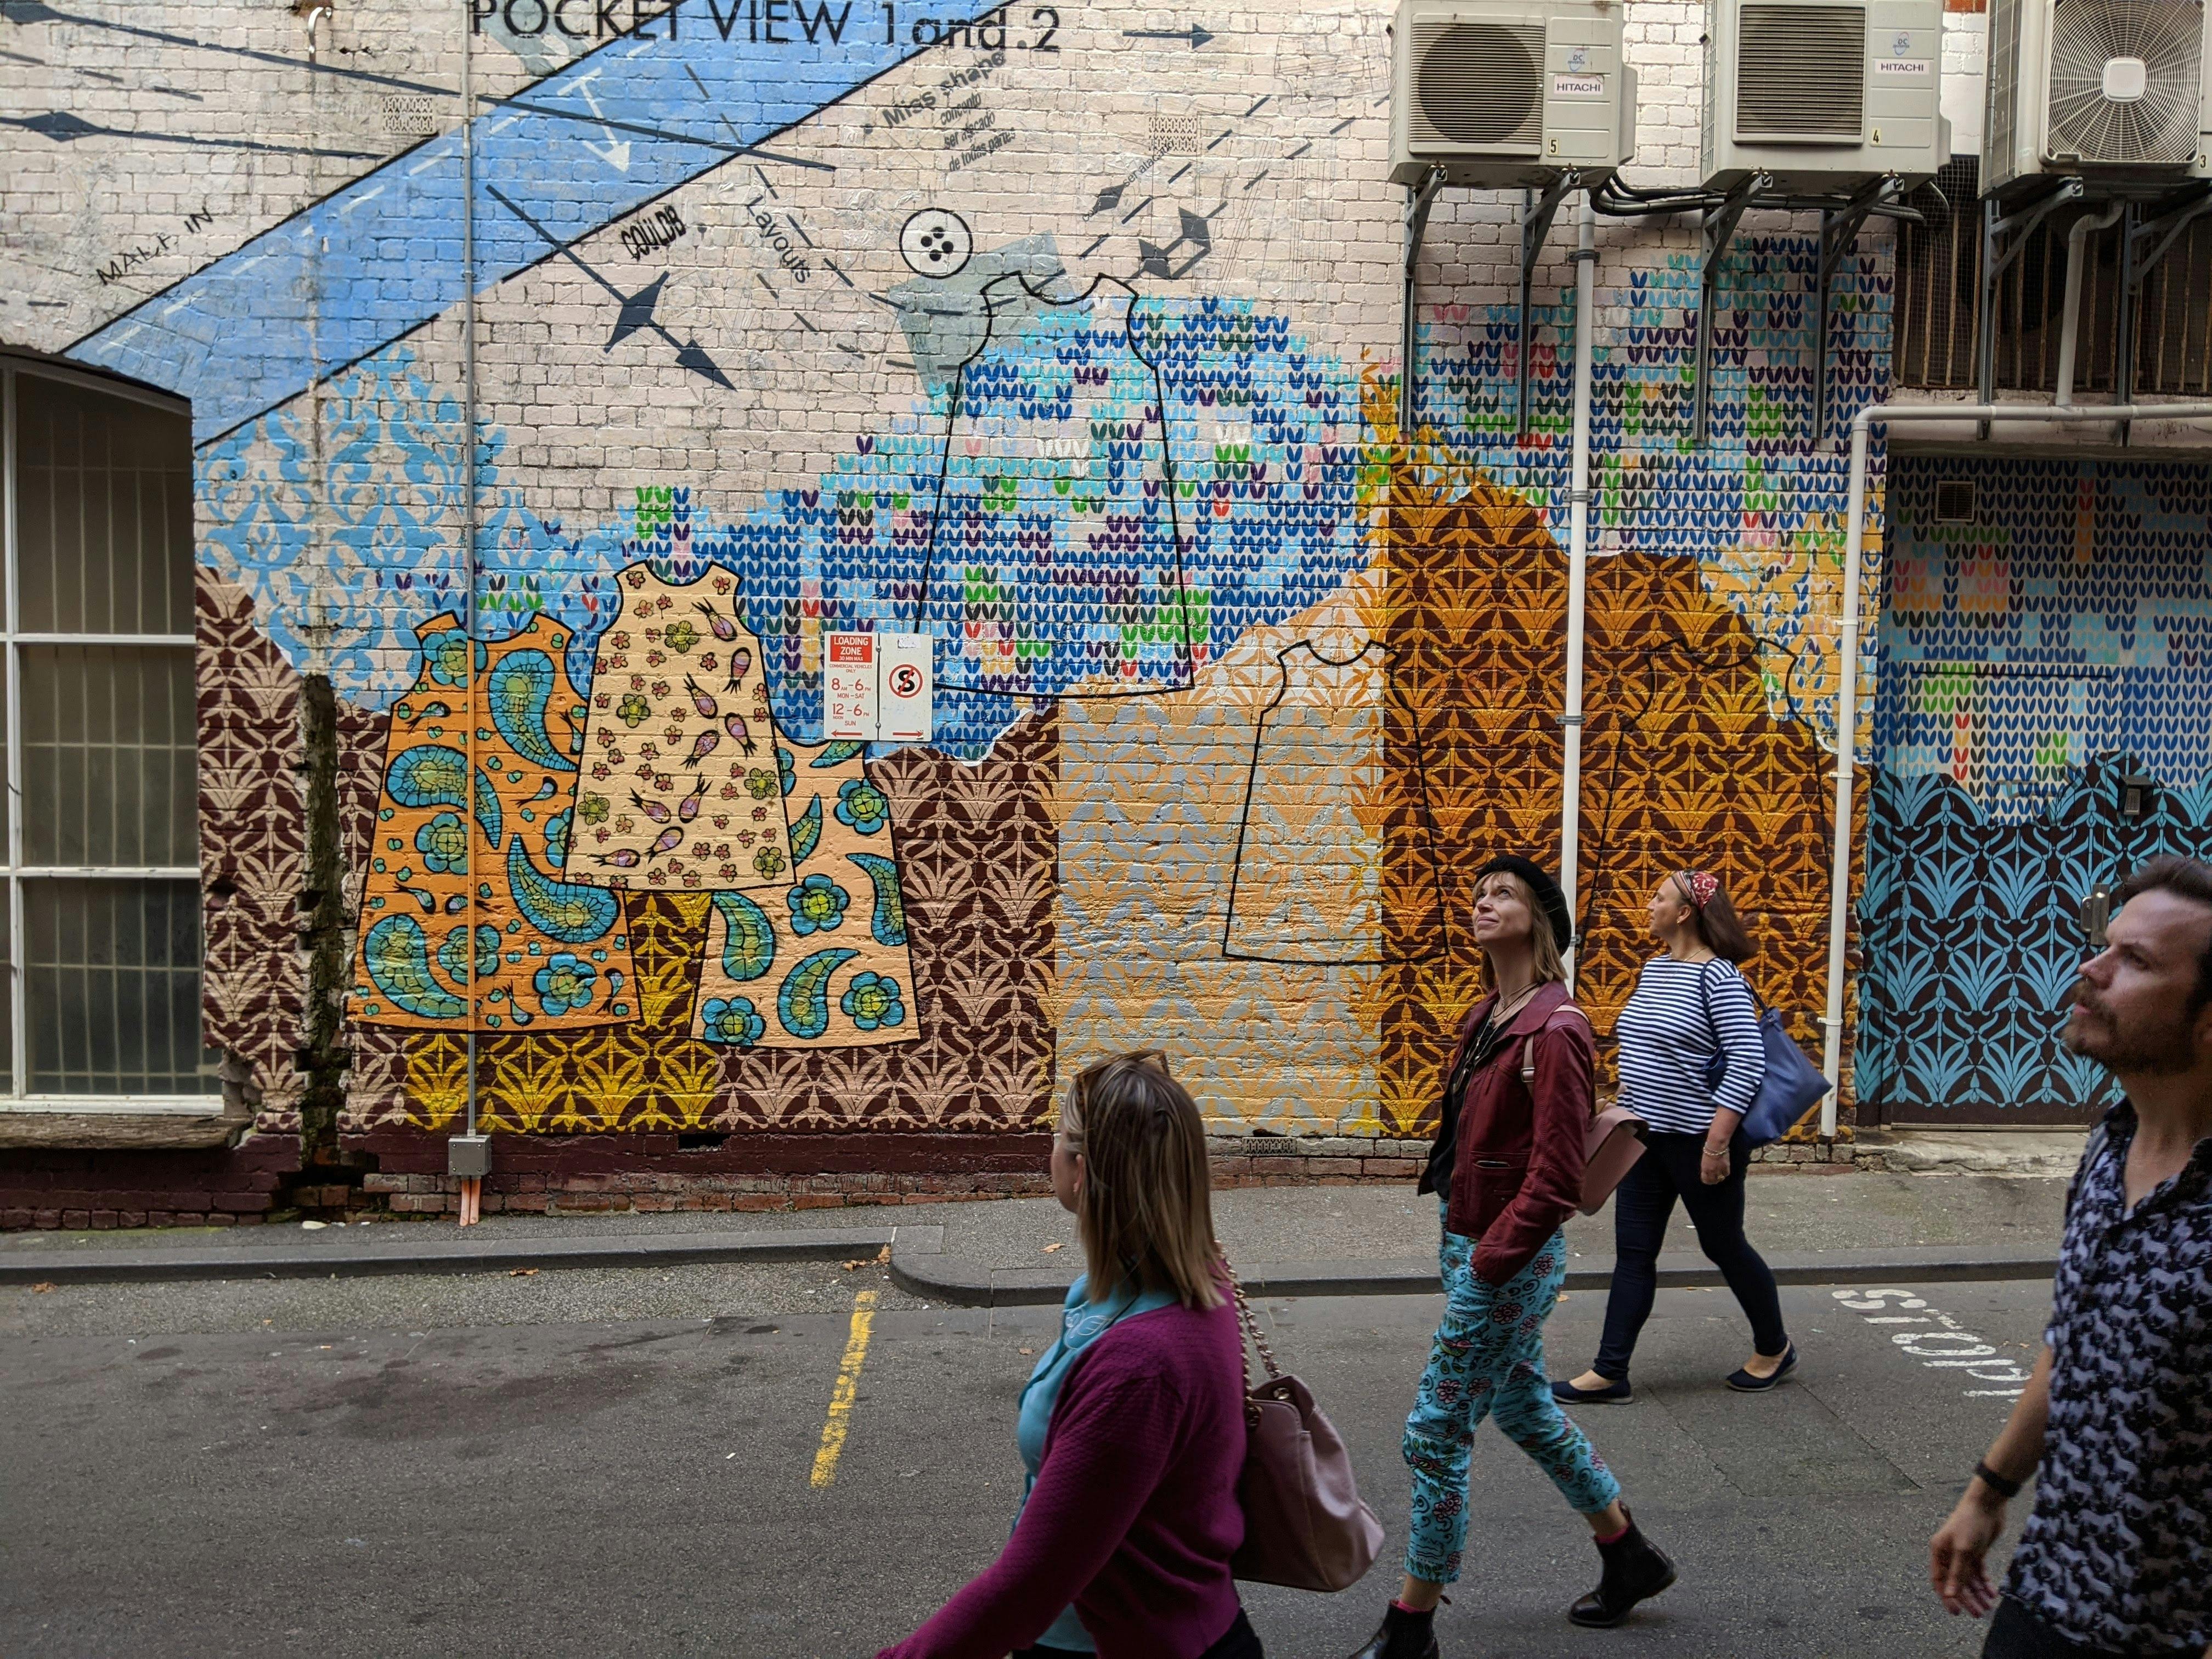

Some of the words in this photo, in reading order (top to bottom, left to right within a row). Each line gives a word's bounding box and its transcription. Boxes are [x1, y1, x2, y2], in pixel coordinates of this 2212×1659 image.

[473, 0, 682, 41] POCKET
[708, 0, 851, 46] VIEW
[912, 8, 1006, 50] and
[1881, 63, 1924, 71] HITACHI
[1556, 83, 1601, 92] HITACHI
[882, 91, 936, 128] Miss
[1873, 129, 1880, 143] 4
[1550, 139, 1556, 153] 5
[949, 155, 960, 172] de
[2200, 155, 2206, 168] 3
[184, 206, 213, 234] IN
[746, 194, 810, 283] Layouts
[834, 636, 869, 646] LOADING
[840, 646, 862, 656] ZONE
[832, 703, 844, 715] 12
